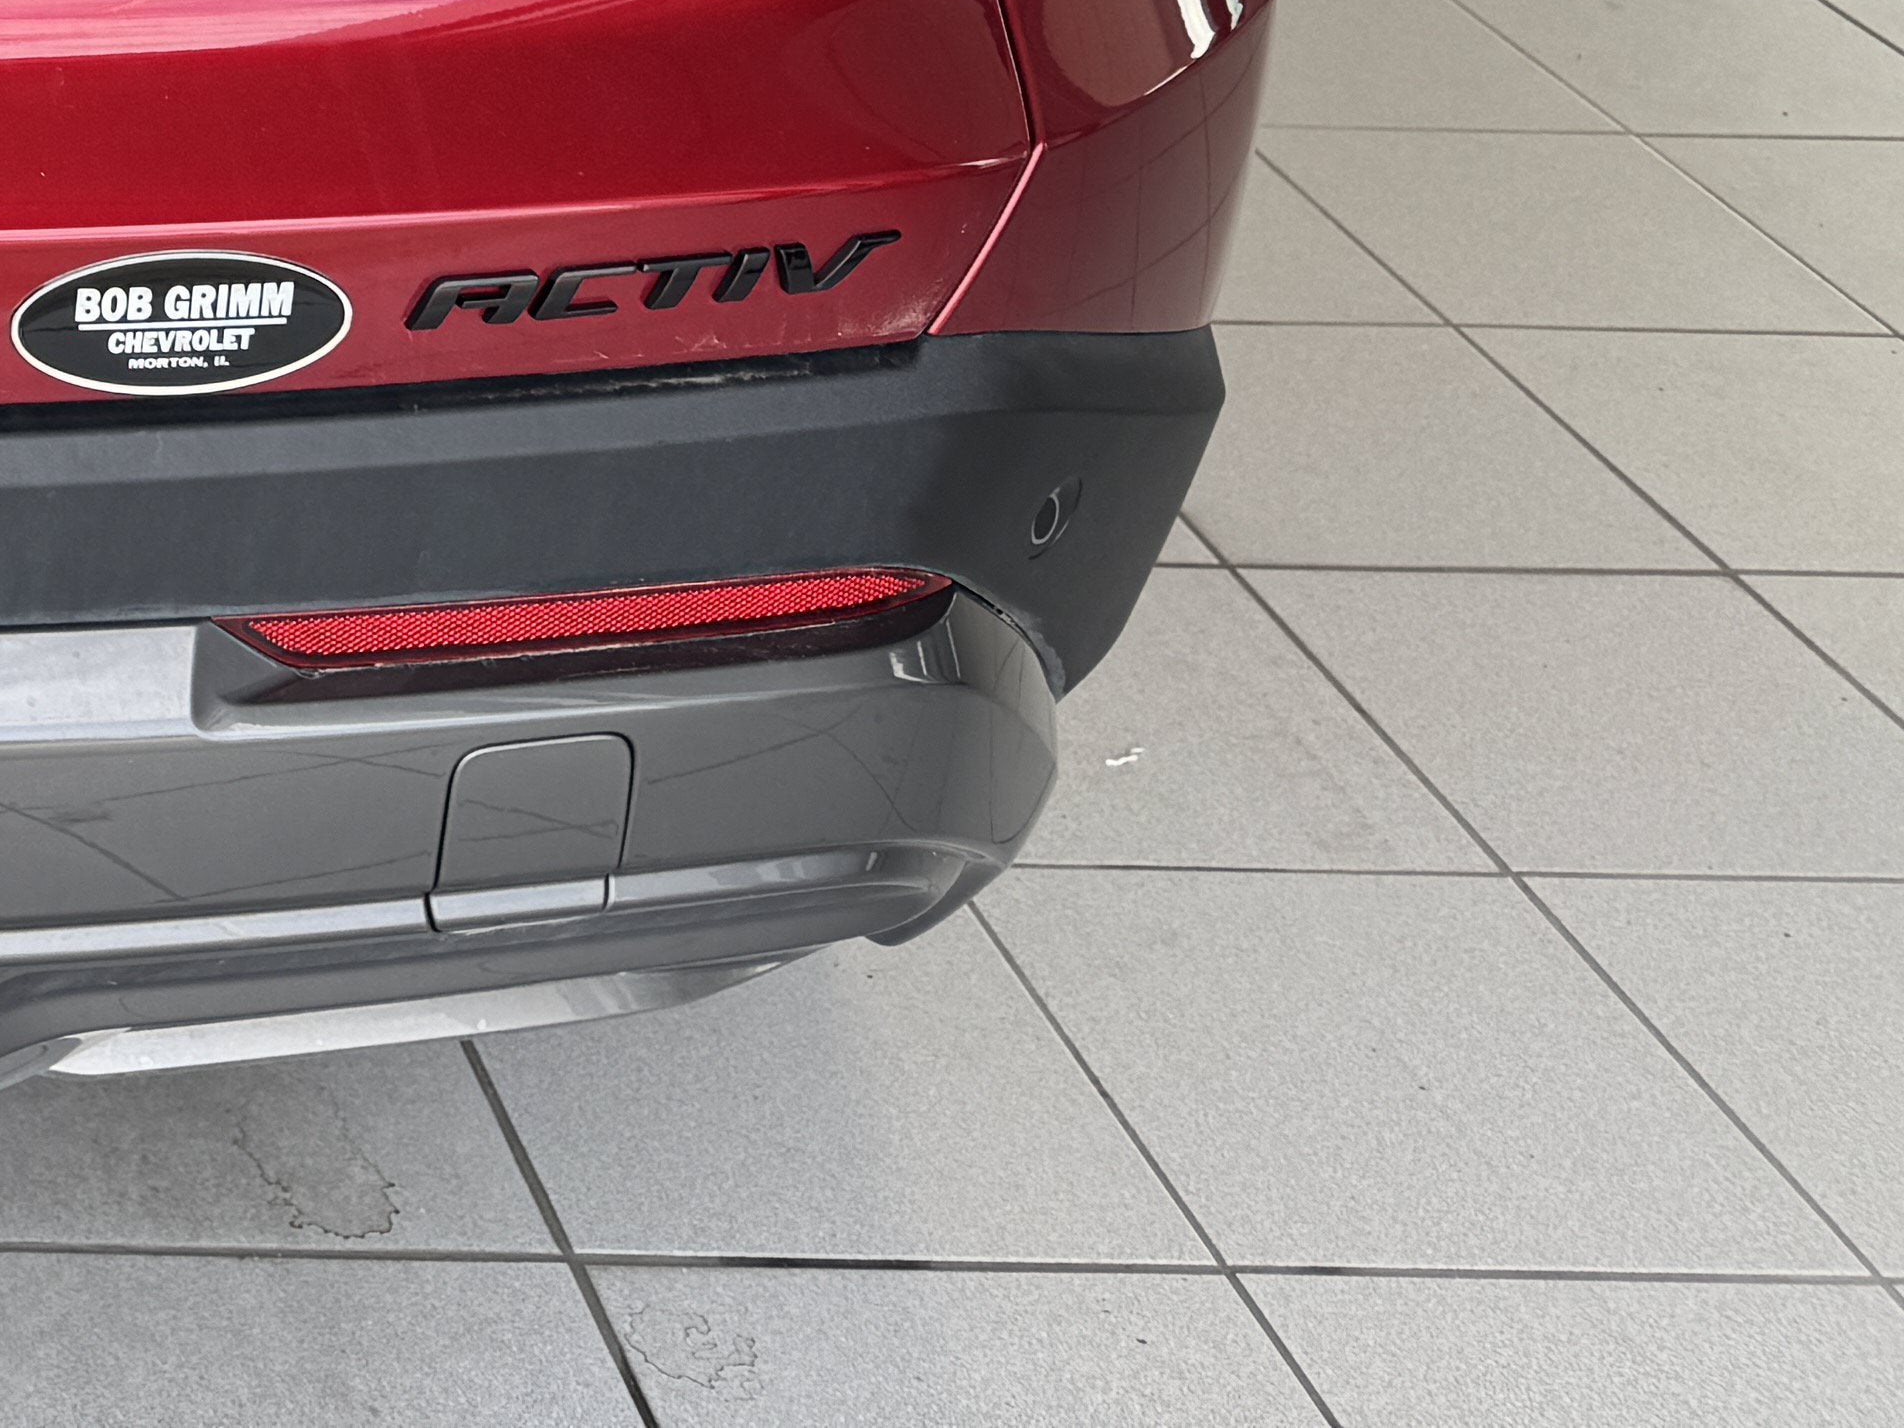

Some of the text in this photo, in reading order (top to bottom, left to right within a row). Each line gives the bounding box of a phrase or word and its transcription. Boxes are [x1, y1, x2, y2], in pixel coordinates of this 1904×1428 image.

[403, 228, 902, 331] ACTIV
[74, 281, 296, 323] BOB GRIMM
[107, 327, 257, 355] CHEVROLET
[128, 356, 210, 370] MORTON,
